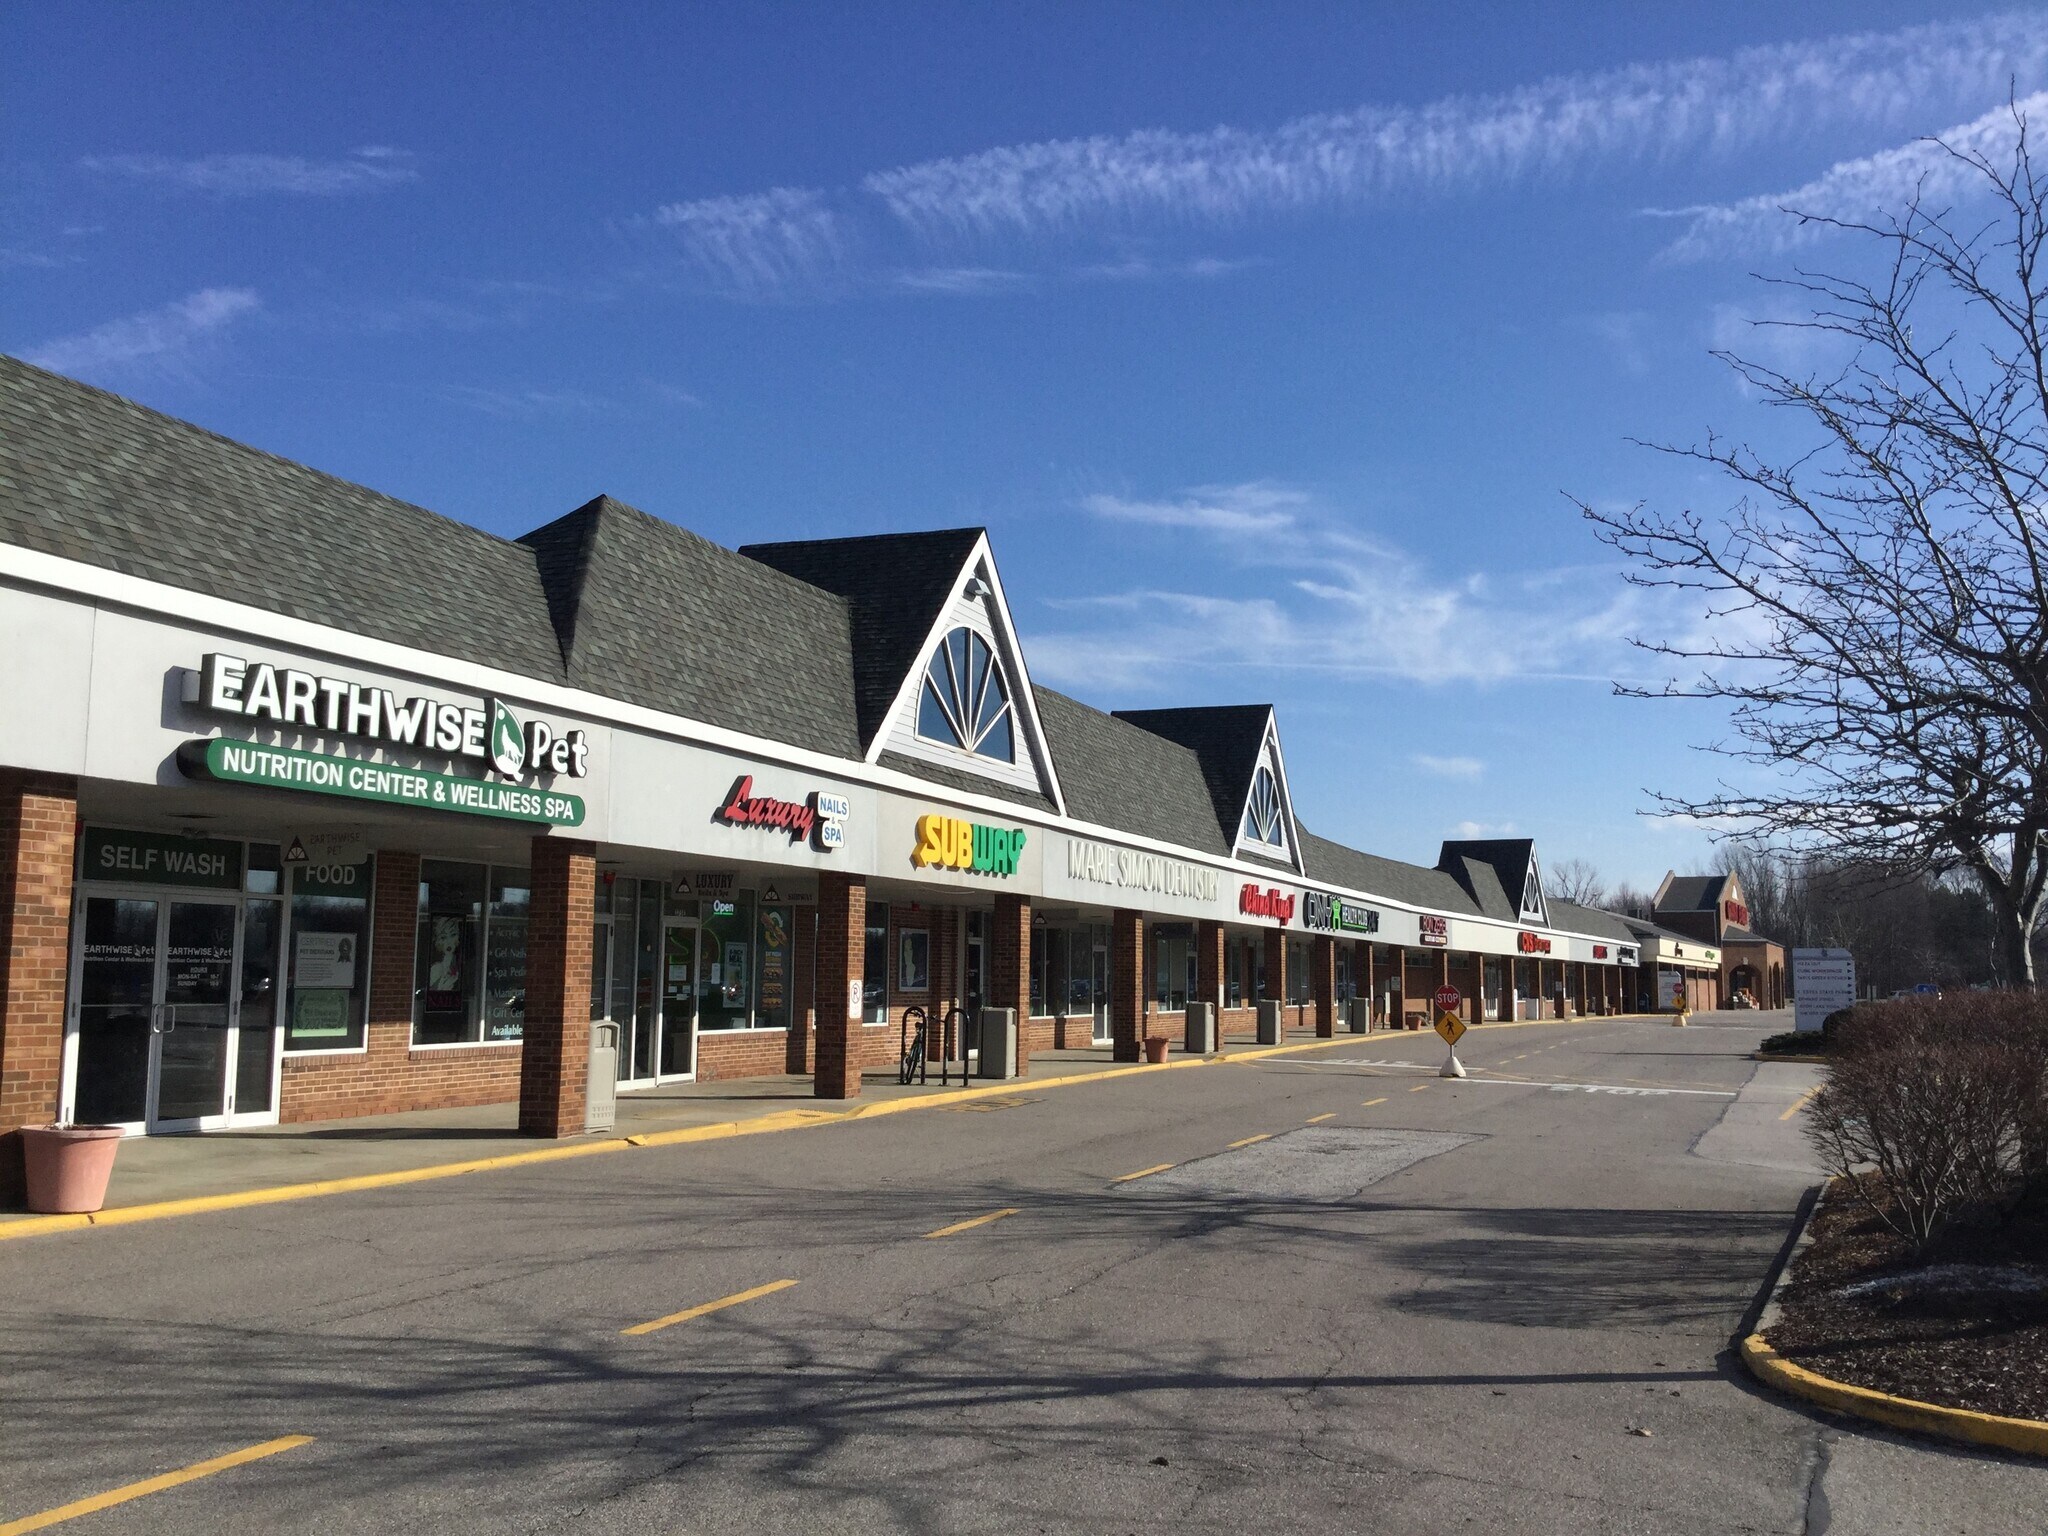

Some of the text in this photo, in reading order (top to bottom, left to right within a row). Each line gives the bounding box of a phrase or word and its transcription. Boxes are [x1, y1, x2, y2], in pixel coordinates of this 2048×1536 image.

[205, 652, 589, 778] EARTHWISE Pet
[222, 746, 575, 821] NUTRITION CENTER & WELLNESS SPA
[724, 774, 815, 842] Luxury
[819, 796, 848, 816] NAILS
[823, 825, 843, 843] SPA
[911, 814, 1028, 876] SUBWAY
[100, 844, 226, 876] SELF WASH
[305, 864, 356, 885] FOOD
[1068, 840, 1221, 901] MARIE SIMON DENTISTRY
[695, 874, 734, 888] LUXURY
[713, 899, 734, 912] Open
[84, 945, 132, 955] EARTHWISE
[168, 947, 212, 956] EARTHWISE
[1437, 993, 1458, 1003] STOP
[491, 1024, 523, 1036] Available
